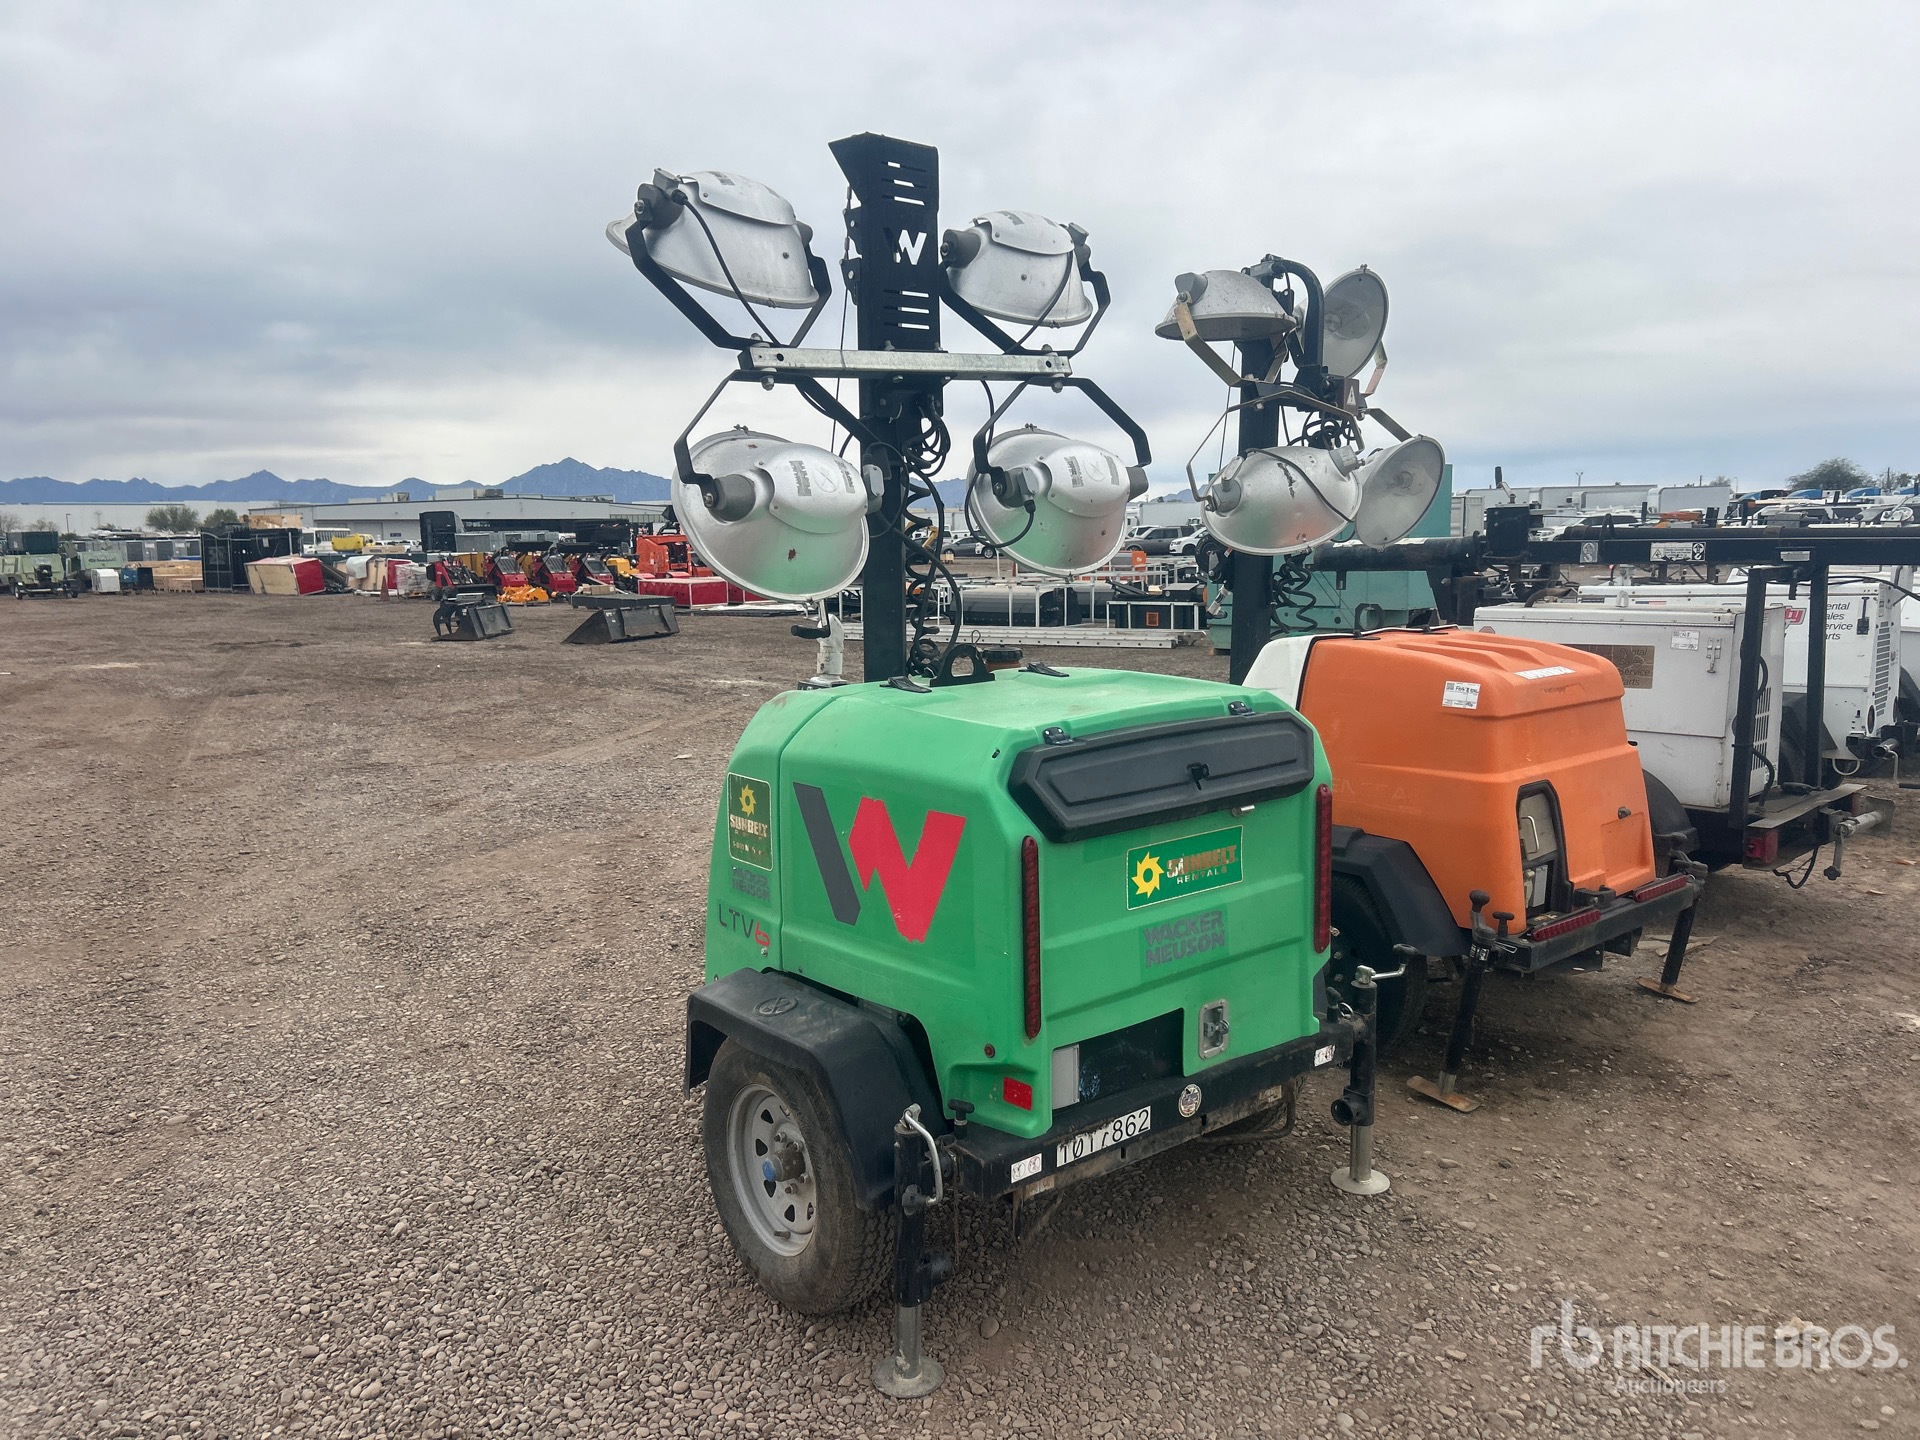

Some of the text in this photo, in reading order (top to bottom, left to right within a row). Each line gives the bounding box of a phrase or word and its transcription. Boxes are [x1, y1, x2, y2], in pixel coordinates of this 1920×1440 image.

[1825, 612, 1845, 620] ales
[1826, 602, 1850, 610] ental
[1824, 632, 1841, 640] arts
[1825, 622, 1853, 630] ervice
[1622, 678, 1640, 686] arts
[729, 814, 768, 838] SUNBELT
[793, 781, 967, 943] W
[1166, 845, 1236, 878] SUNBELT
[717, 904, 770, 947] LTV6
[1143, 909, 1225, 945] WACKER
[1145, 930, 1226, 968] NEUSON
